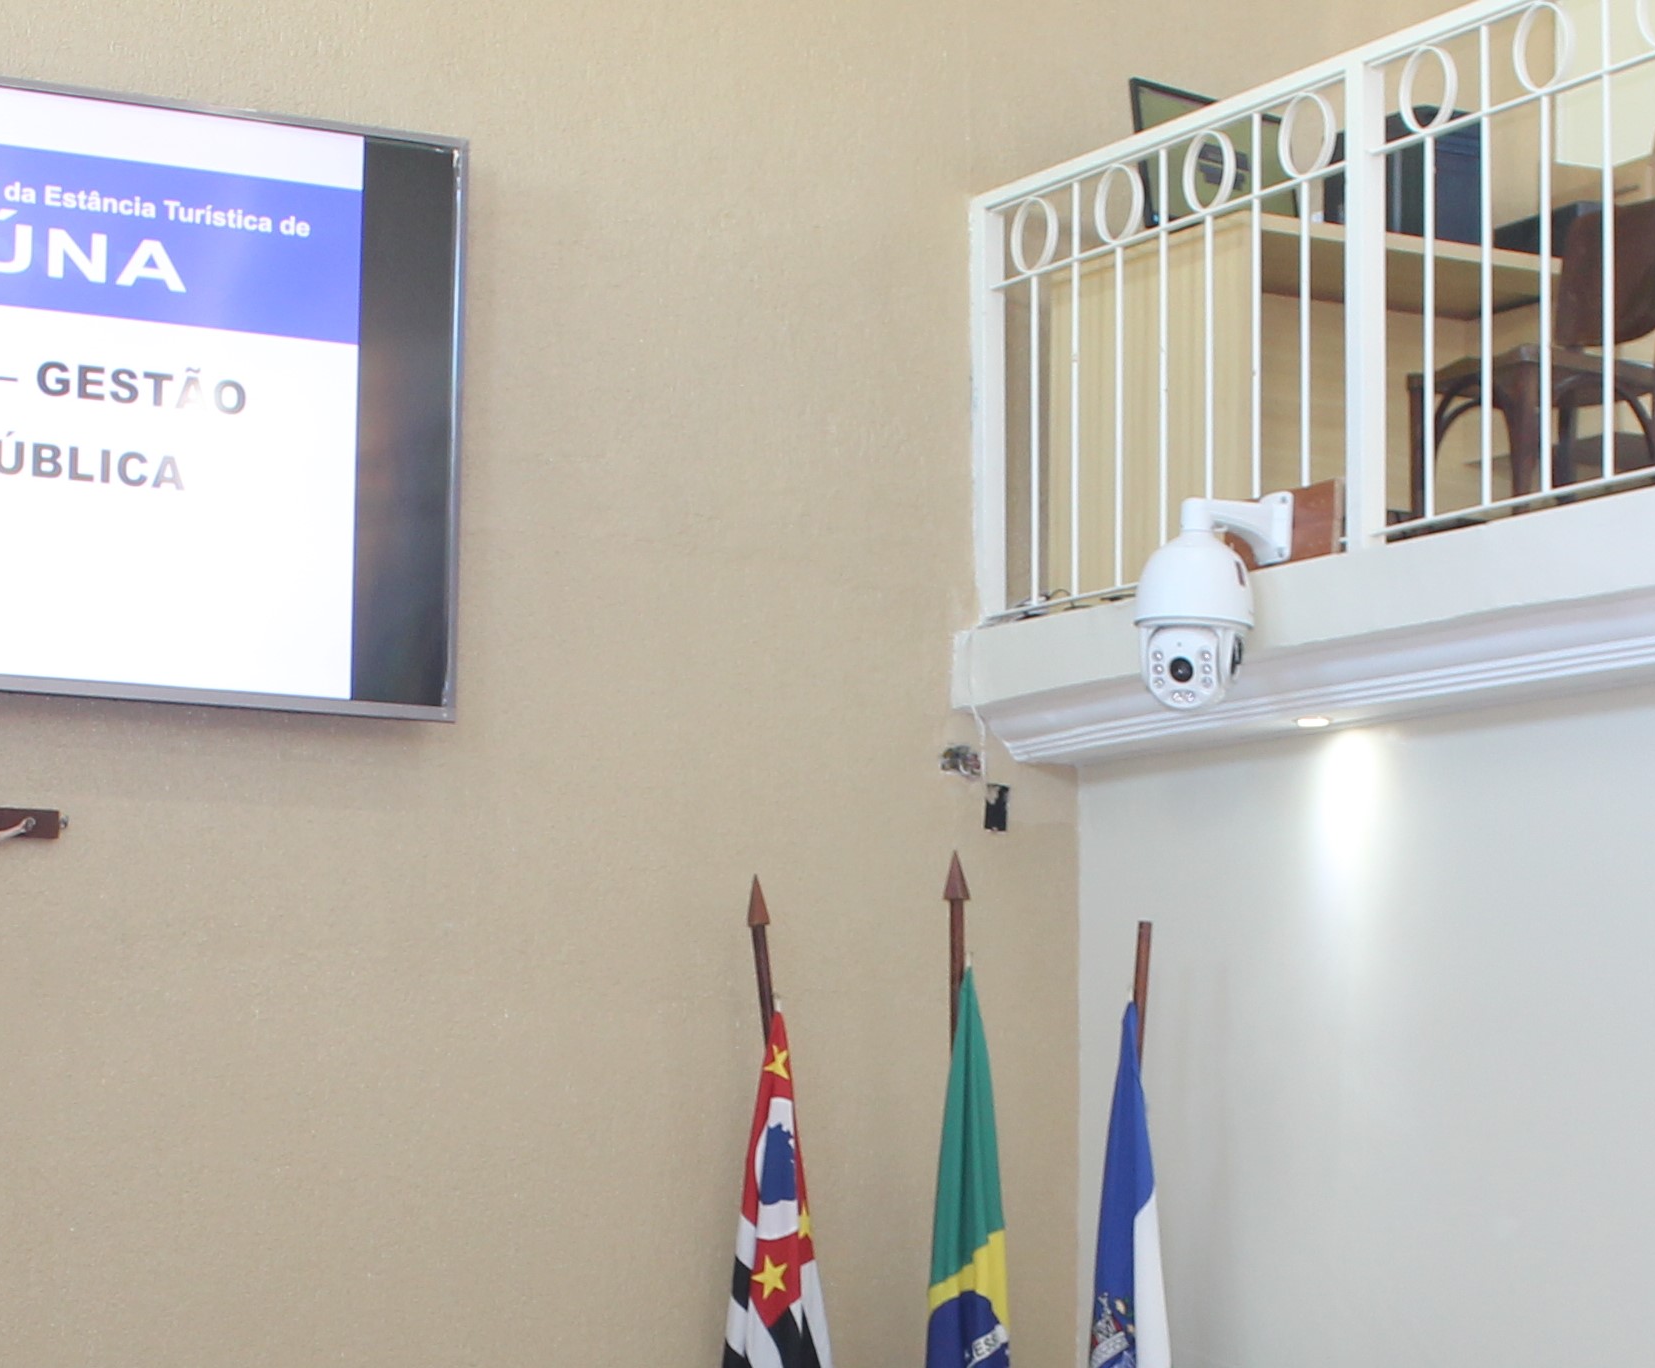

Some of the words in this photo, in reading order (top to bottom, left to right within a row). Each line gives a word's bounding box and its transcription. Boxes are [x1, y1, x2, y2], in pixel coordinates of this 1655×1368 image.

[2, 180, 37, 205] da
[43, 183, 156, 219] Estância
[162, 198, 273, 233] Turística
[278, 215, 311, 237] de
[36, 361, 247, 415] GESTÃO
